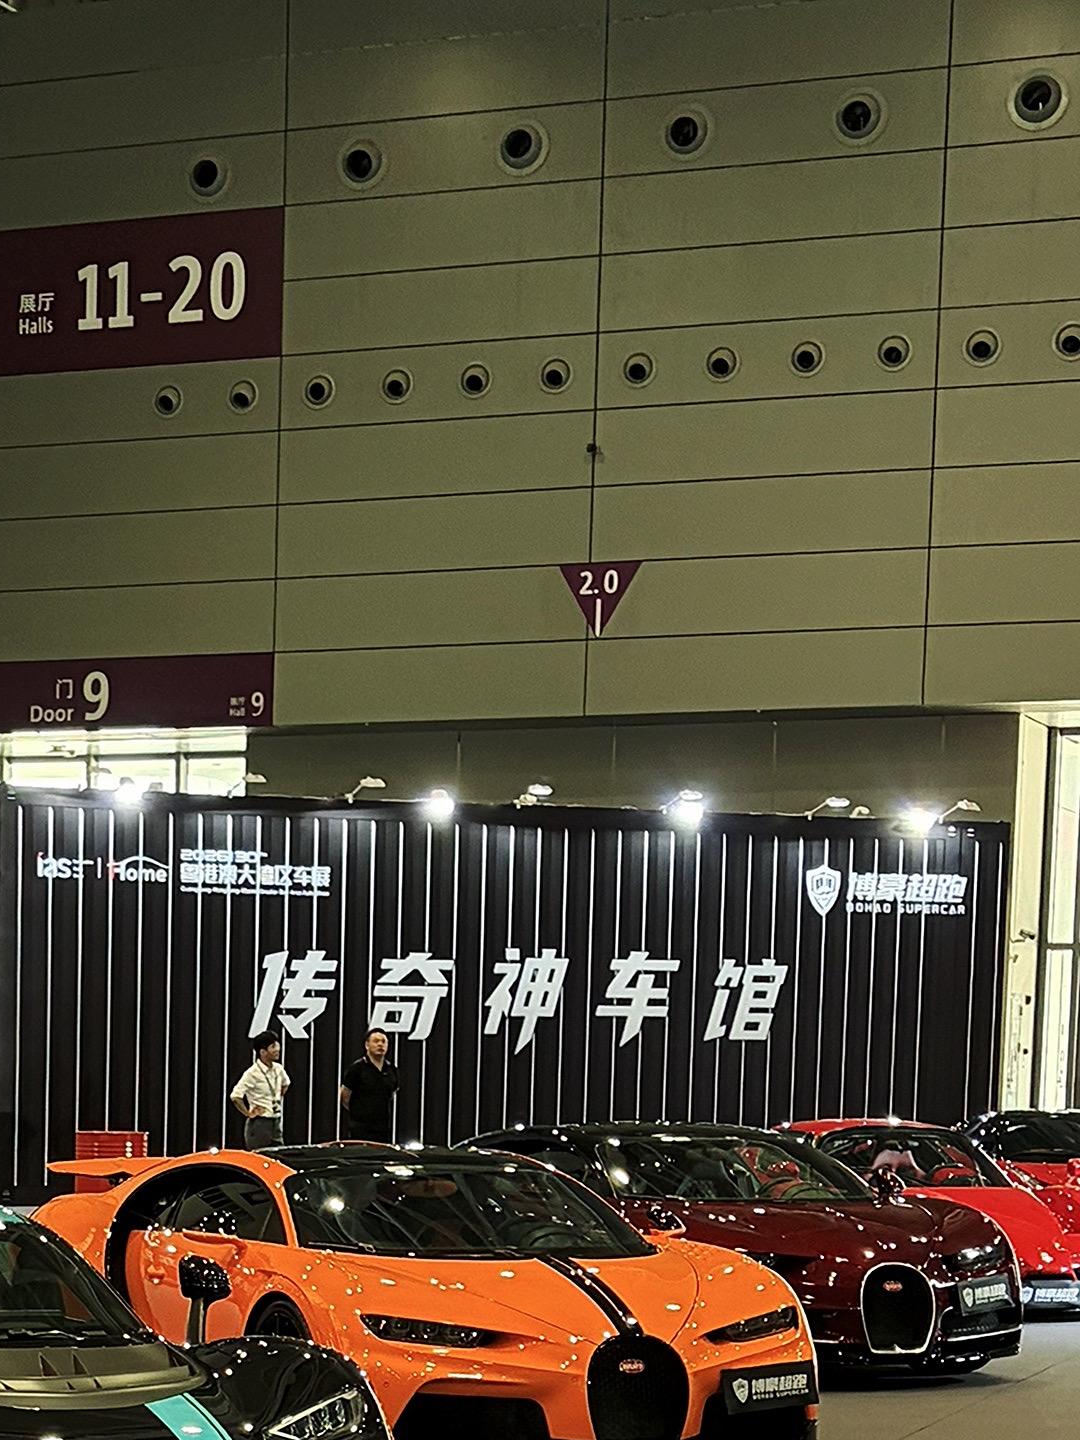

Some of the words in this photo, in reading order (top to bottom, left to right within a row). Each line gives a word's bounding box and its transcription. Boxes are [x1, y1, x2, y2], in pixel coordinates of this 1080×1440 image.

[19, 292, 55, 313] 展厅
[77, 250, 247, 332] 11-20
[19, 317, 54, 335] Halls
[579, 569, 619, 595] 2.0
[56, 679, 73, 700] 门
[82, 671, 110, 722] 9
[30, 705, 76, 723] Door
[251, 691, 265, 717] 9
[846, 871, 968, 903] 博豪超跑
[897, 903, 967, 915] SUPERCAR
[248, 947, 789, 1056] 传奇神车馆
